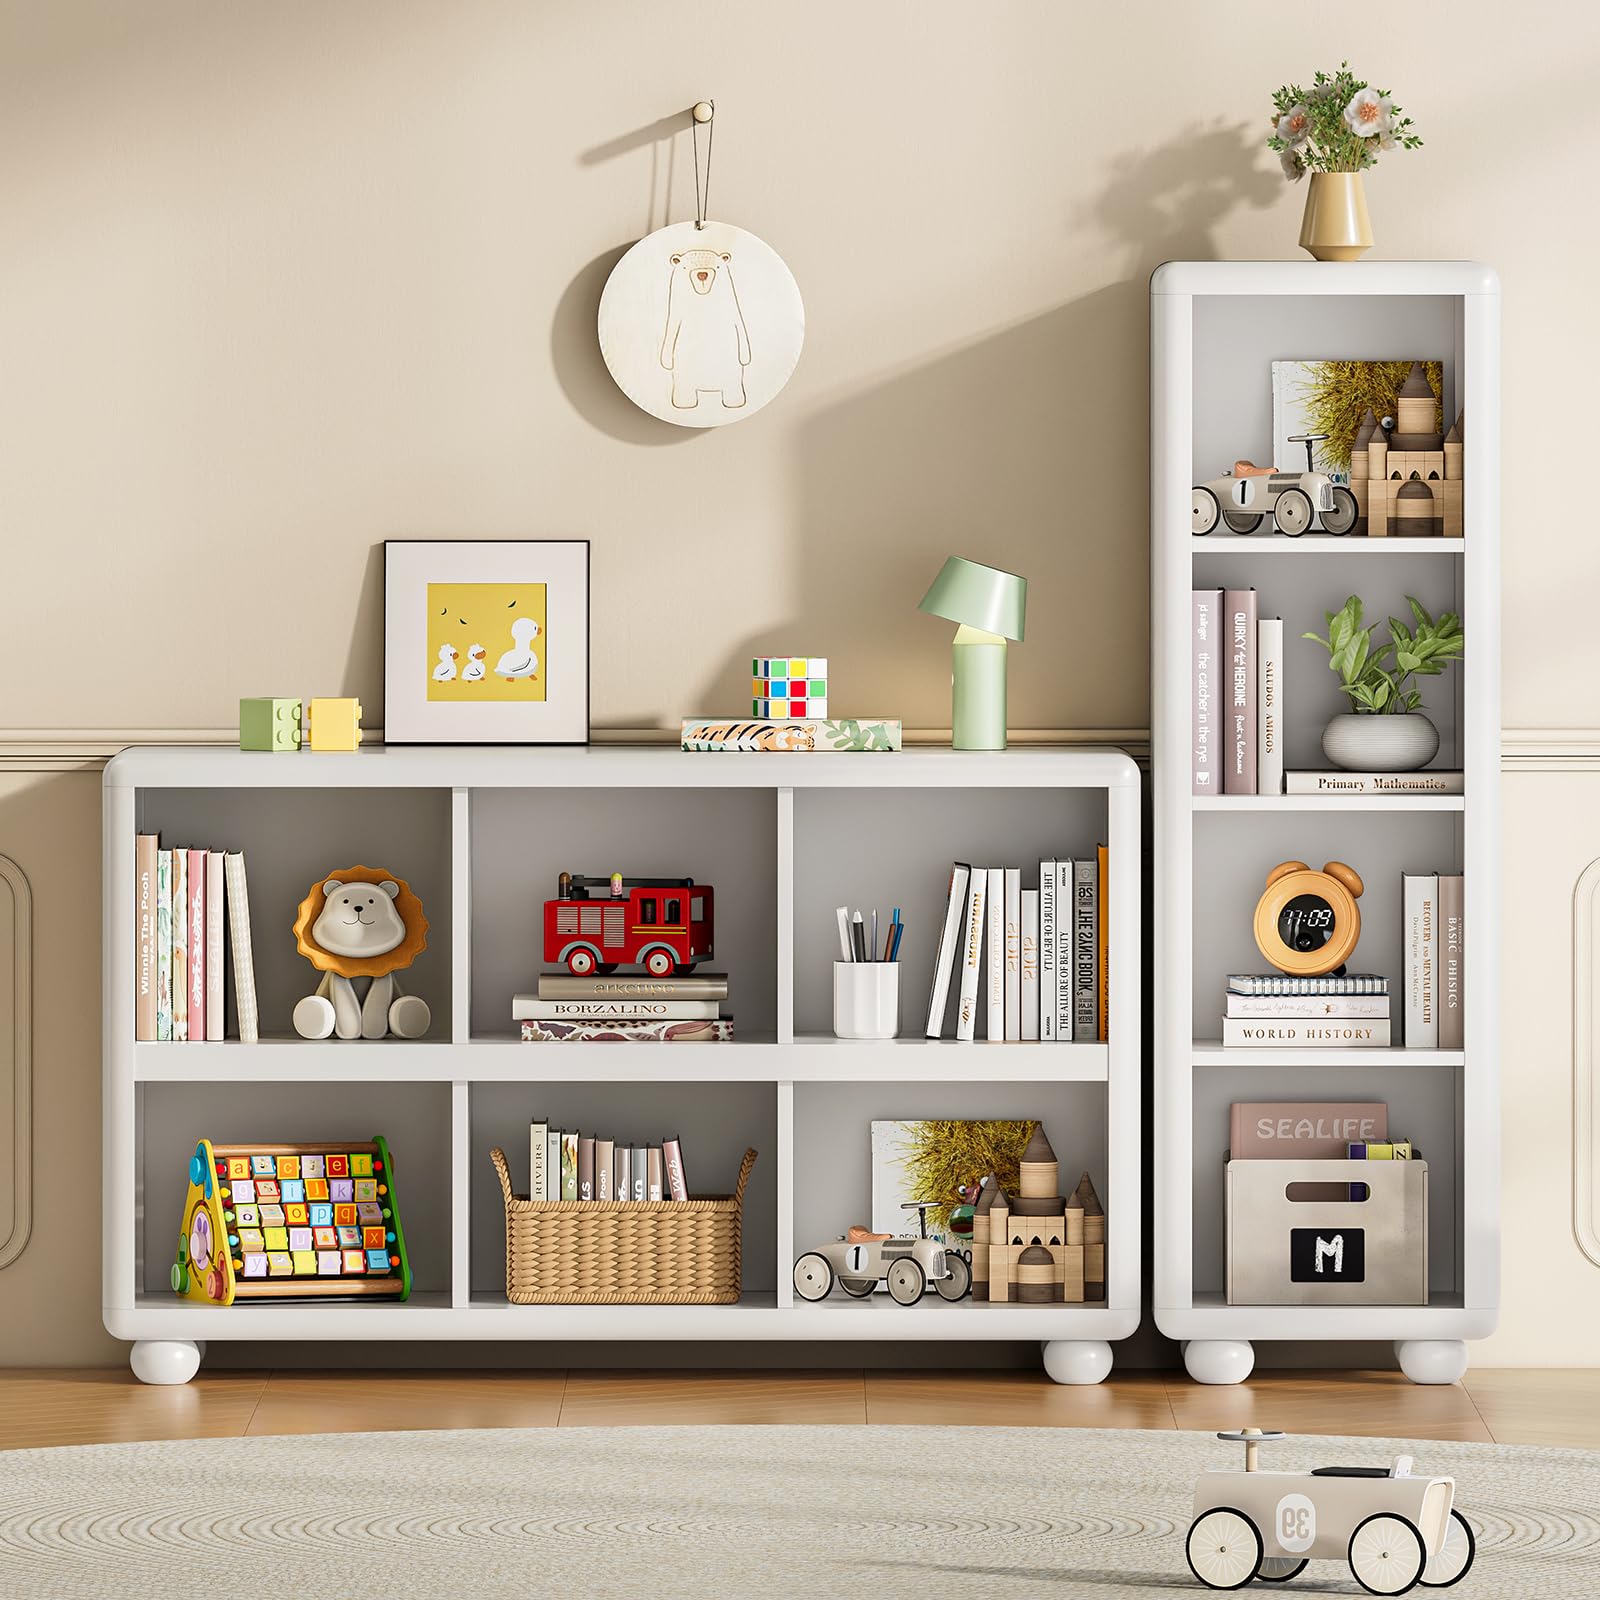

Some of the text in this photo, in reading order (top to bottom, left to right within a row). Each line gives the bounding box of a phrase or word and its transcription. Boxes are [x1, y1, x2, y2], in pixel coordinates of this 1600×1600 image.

[1239, 480, 1248, 504] 1
[1233, 612, 1247, 650] QUIRKY
[1233, 667, 1247, 707] HEROINE
[1196, 652, 1210, 763] the catcher in the rye
[1265, 661, 1274, 754] SALUDOS AMIGOS
[1318, 778, 1446, 791] Primary Mathematics
[1285, 909, 1332, 927] 11:09
[1423, 900, 1431, 942] RECOVERY
[141, 872, 149, 995] Winnie The Pooh
[1423, 959, 1431, 991] MENTAL
[1448, 917, 1457, 1009] BASIC PHISICS
[1059, 931, 1069, 1030] THE ALLURE OF BEAUTY
[554, 1005, 668, 1014] BORZALINO
[1423, 992, 1431, 1024] HEALTH
[1242, 1029, 1373, 1039] WORLD HISTORY
[1256, 1118, 1376, 1139] SEALIFE
[234, 1159, 364, 1174] a c e f
[669, 1159, 680, 1193] Web
[337, 1183, 346, 1197] k
[317, 1207, 327, 1220] p
[341, 1207, 350, 1222] q
[296, 1232, 305, 1245] u
[370, 1232, 379, 1244] x
[252, 1256, 262, 1270] y
[853, 1246, 861, 1270] 1
[1315, 1234, 1344, 1273] M
[207, 1274, 213, 1293] 2
